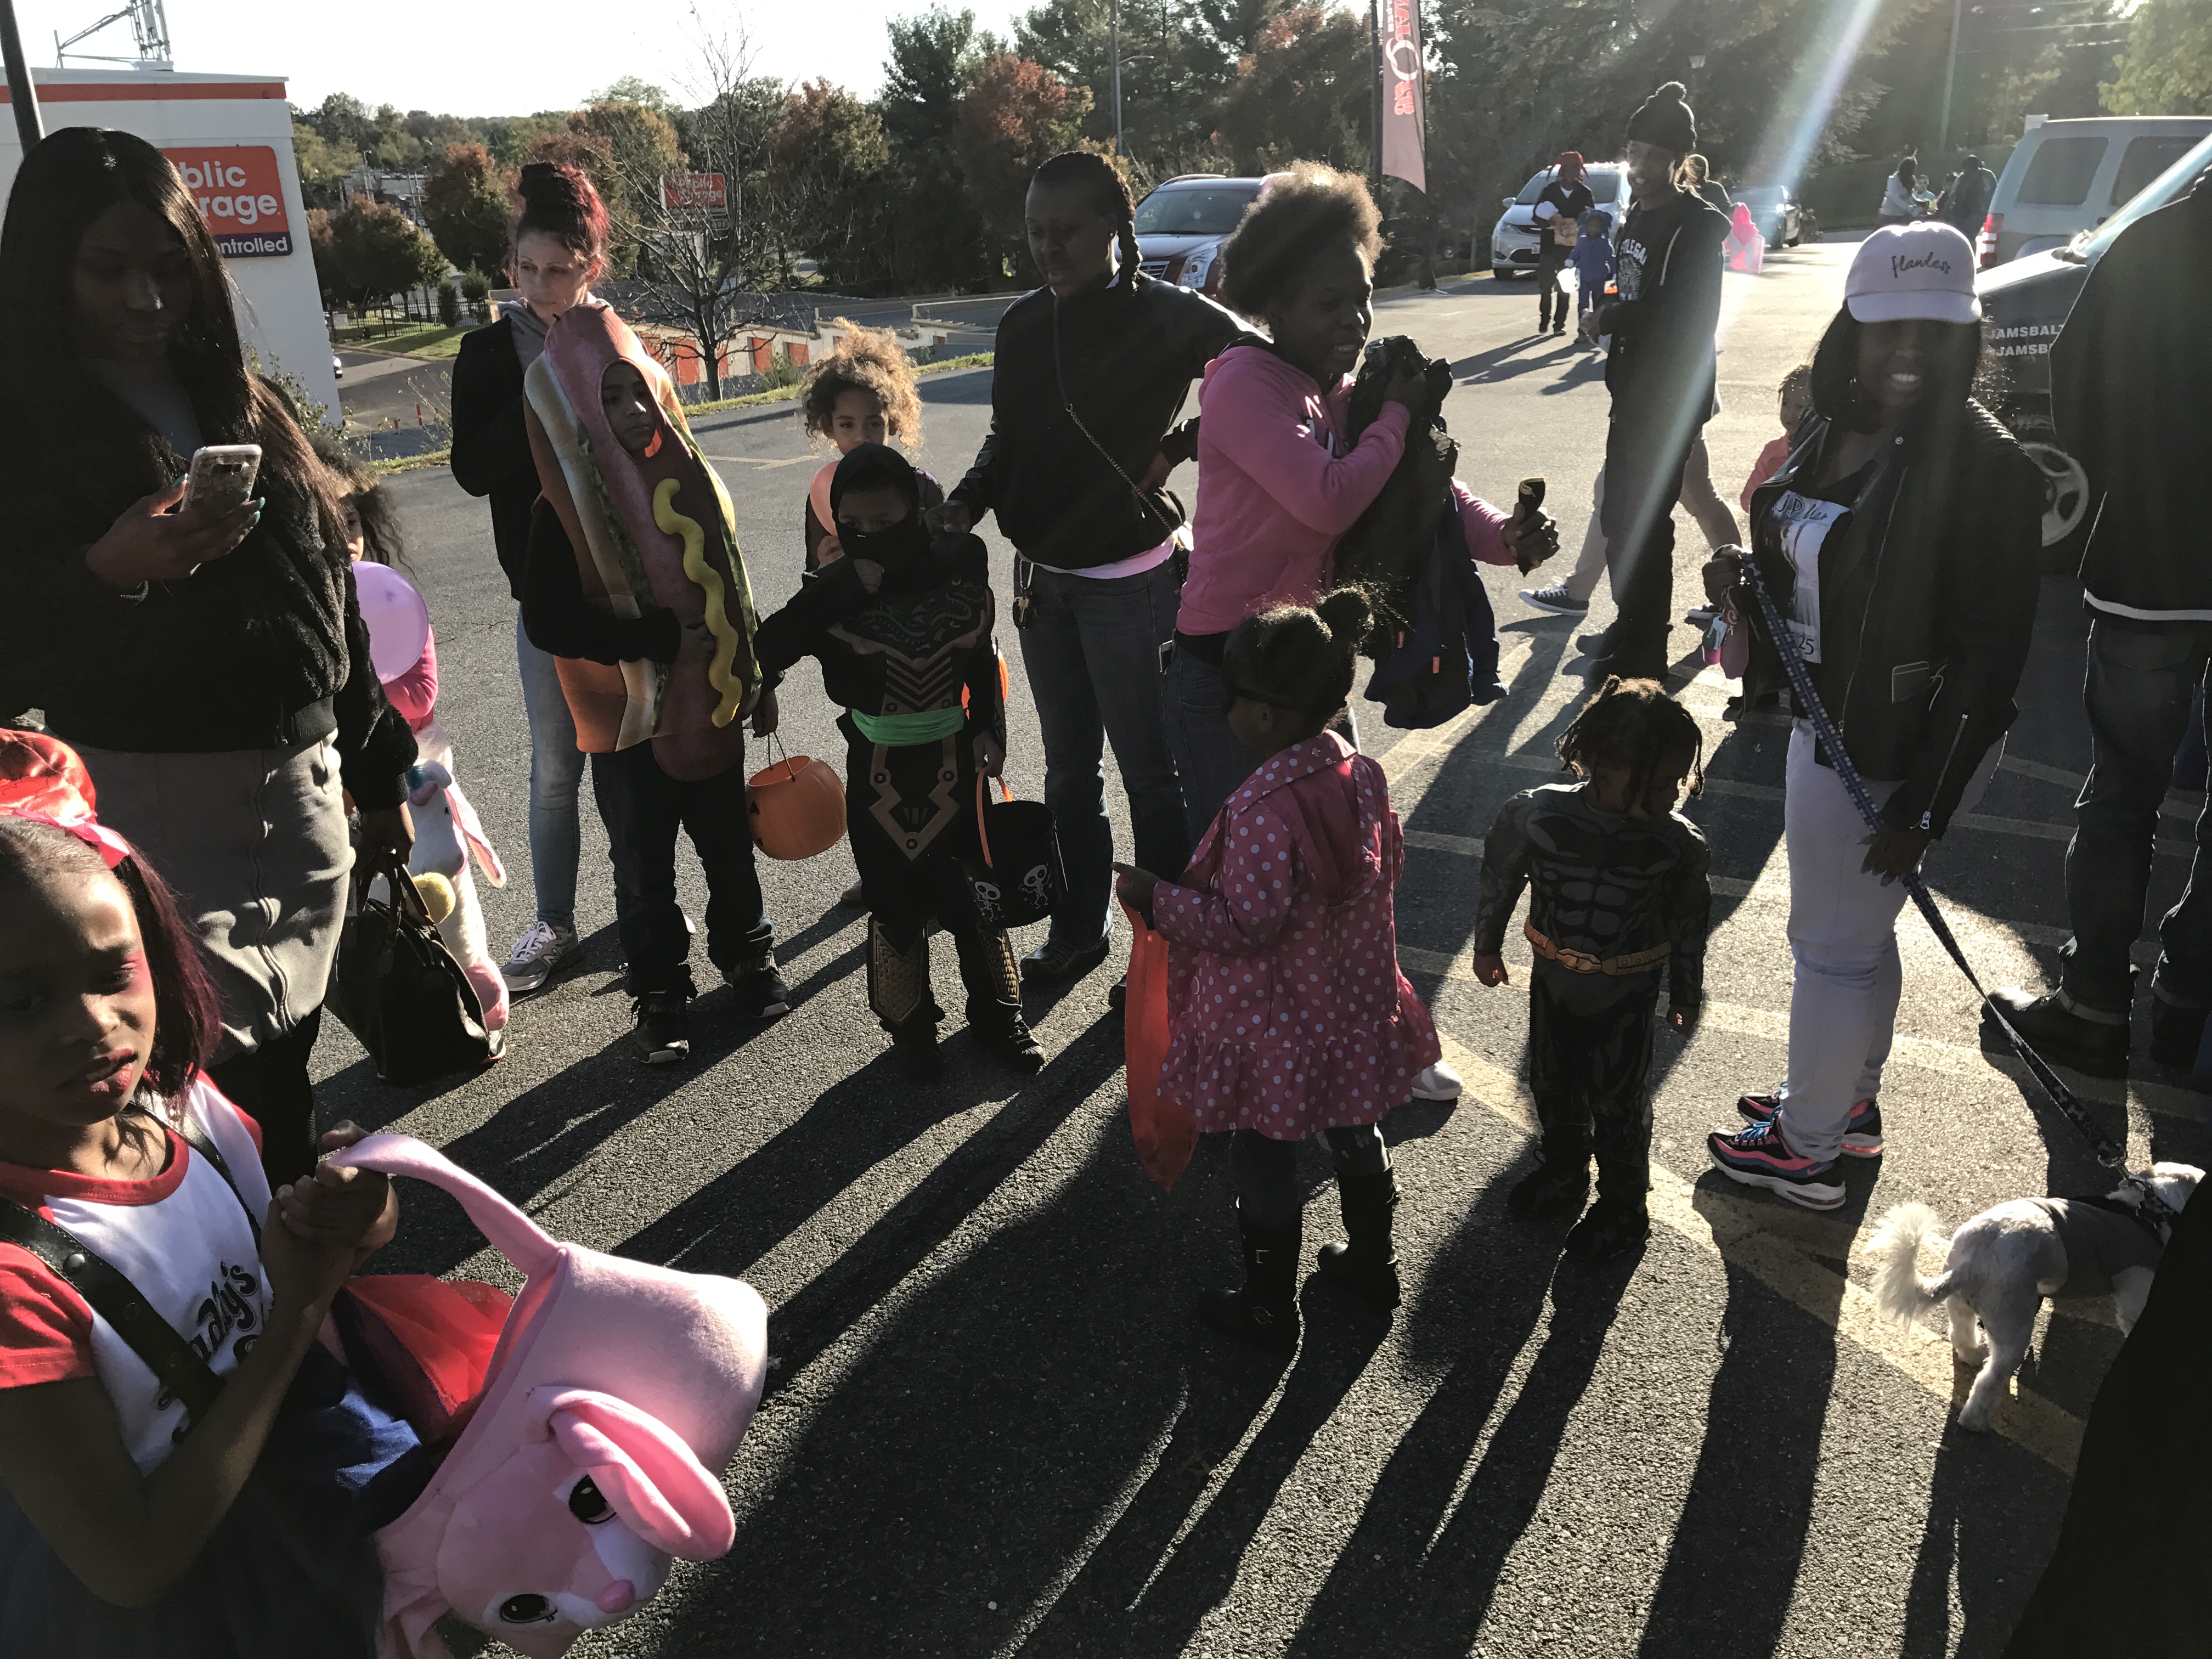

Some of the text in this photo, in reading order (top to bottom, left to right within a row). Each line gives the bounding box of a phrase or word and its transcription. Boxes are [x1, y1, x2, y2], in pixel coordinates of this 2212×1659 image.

[179, 160, 246, 189] blic
[199, 194, 278, 225] rage
[220, 236, 288, 254] ntrolled
[1995, 343, 2053, 357] JAMSB
